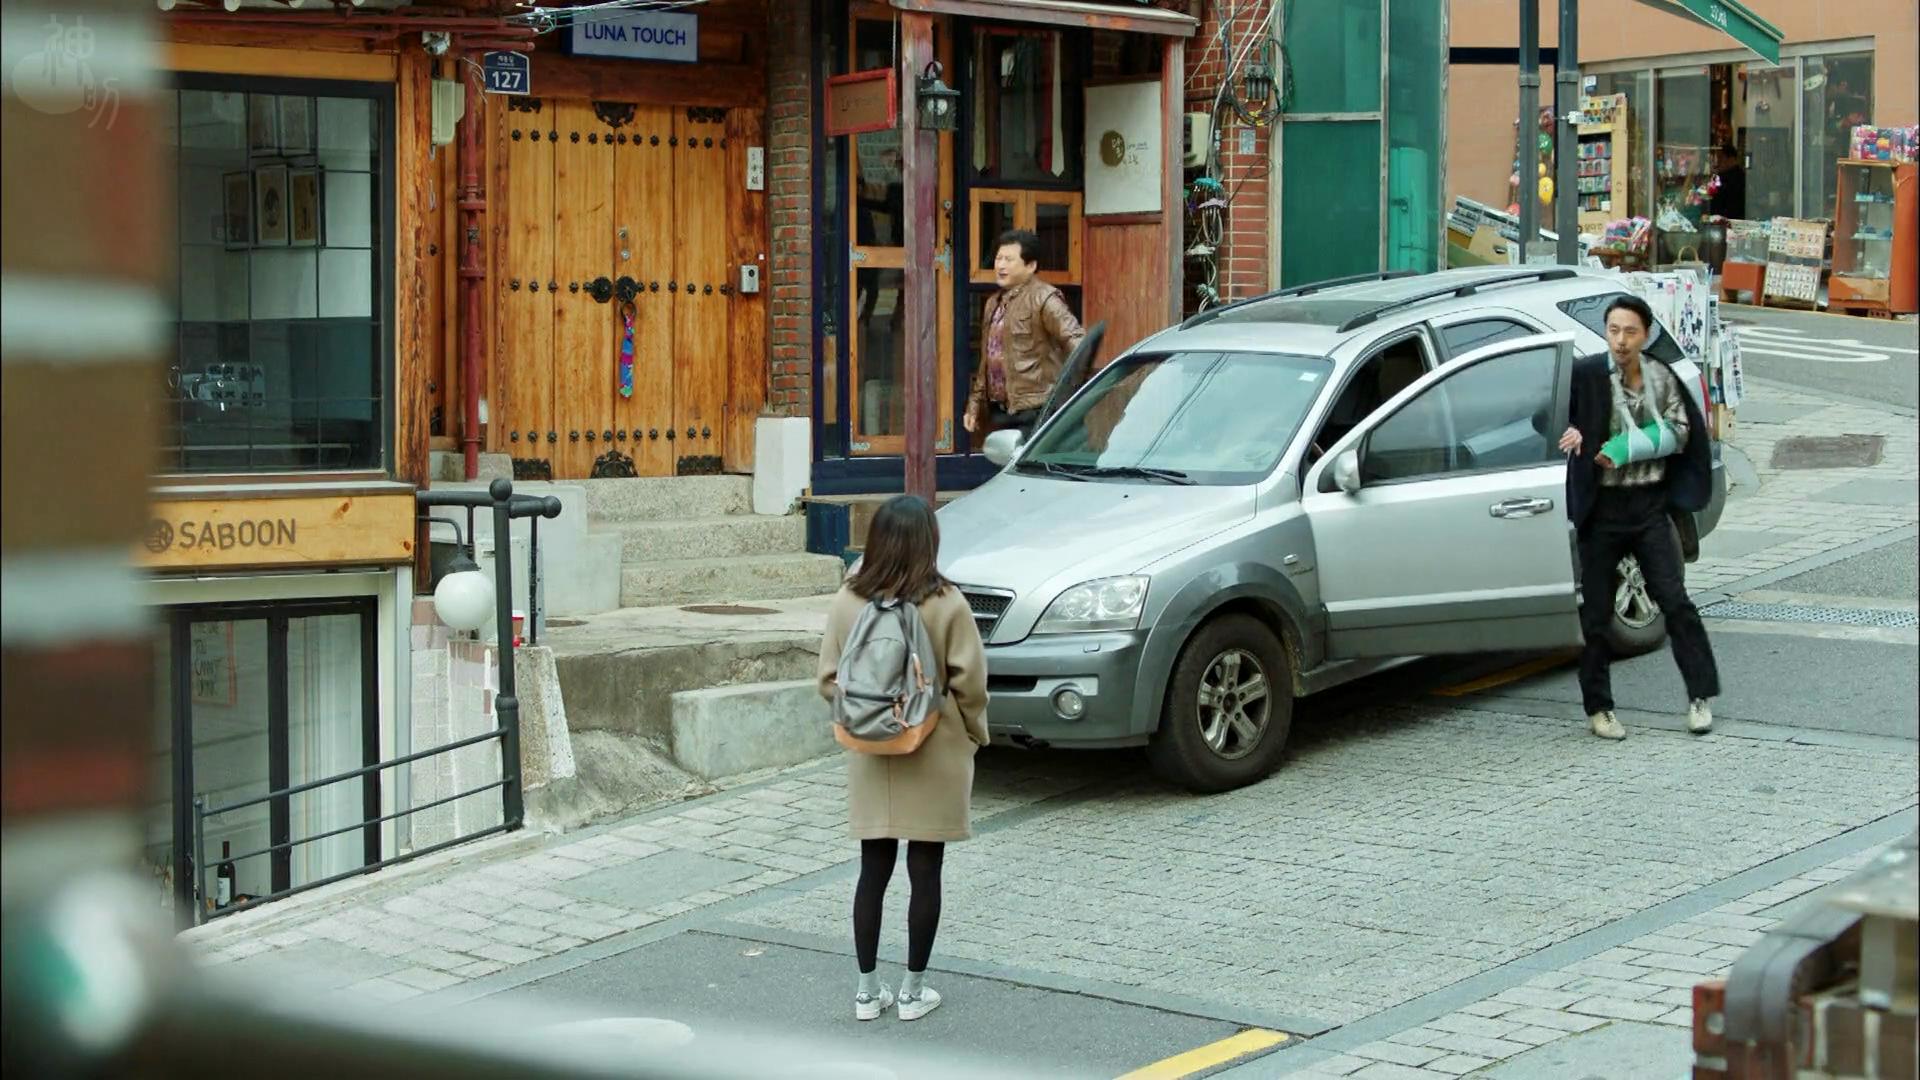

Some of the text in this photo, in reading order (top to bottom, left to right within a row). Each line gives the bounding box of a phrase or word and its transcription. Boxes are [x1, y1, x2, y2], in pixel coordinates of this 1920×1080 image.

[584, 22, 686, 46] LUNA TOUCH
[492, 71, 521, 88] 127
[179, 518, 296, 550] SABOON
